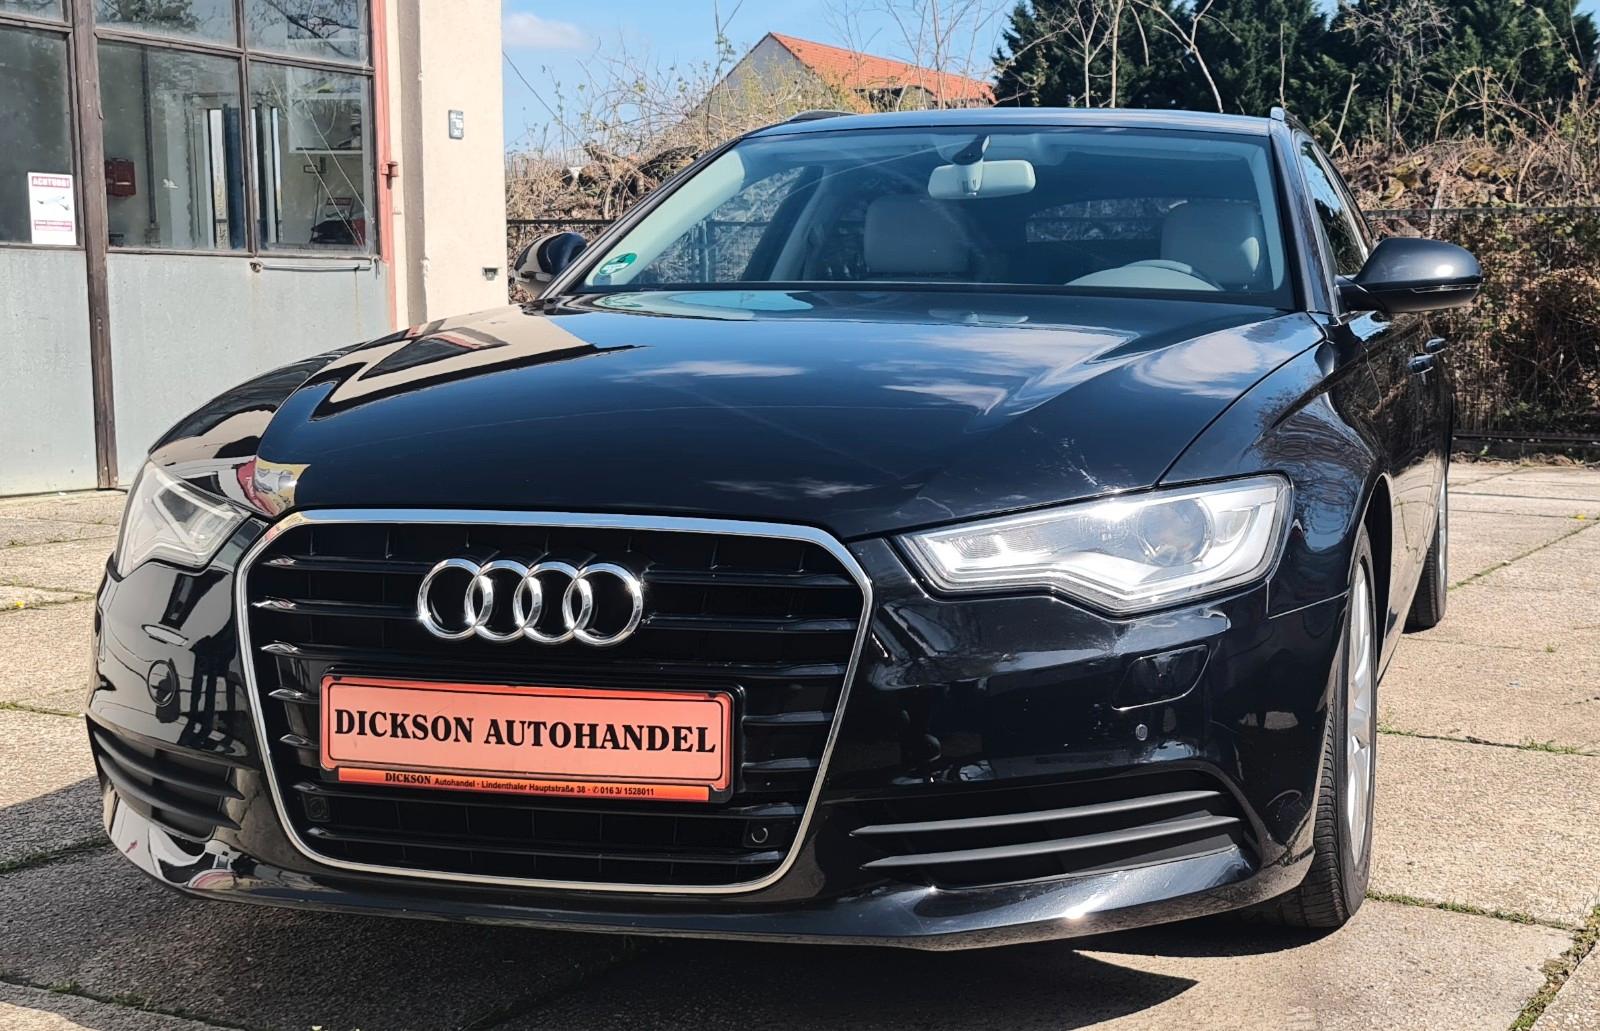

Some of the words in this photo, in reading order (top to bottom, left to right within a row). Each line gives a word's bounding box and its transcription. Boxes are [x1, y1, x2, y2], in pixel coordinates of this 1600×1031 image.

[334, 708, 474, 744] DICKSON
[483, 718, 716, 754] AUTOHANDEL
[385, 772, 431, 785] DICKSON
[434, 778, 476, 788] Autohandel
[481, 780, 527, 790] Lindenthaler
[529, 783, 575, 793] Hauptstraße
[576, 785, 586, 794] 38
[624, 787, 654, 796] 1528011
